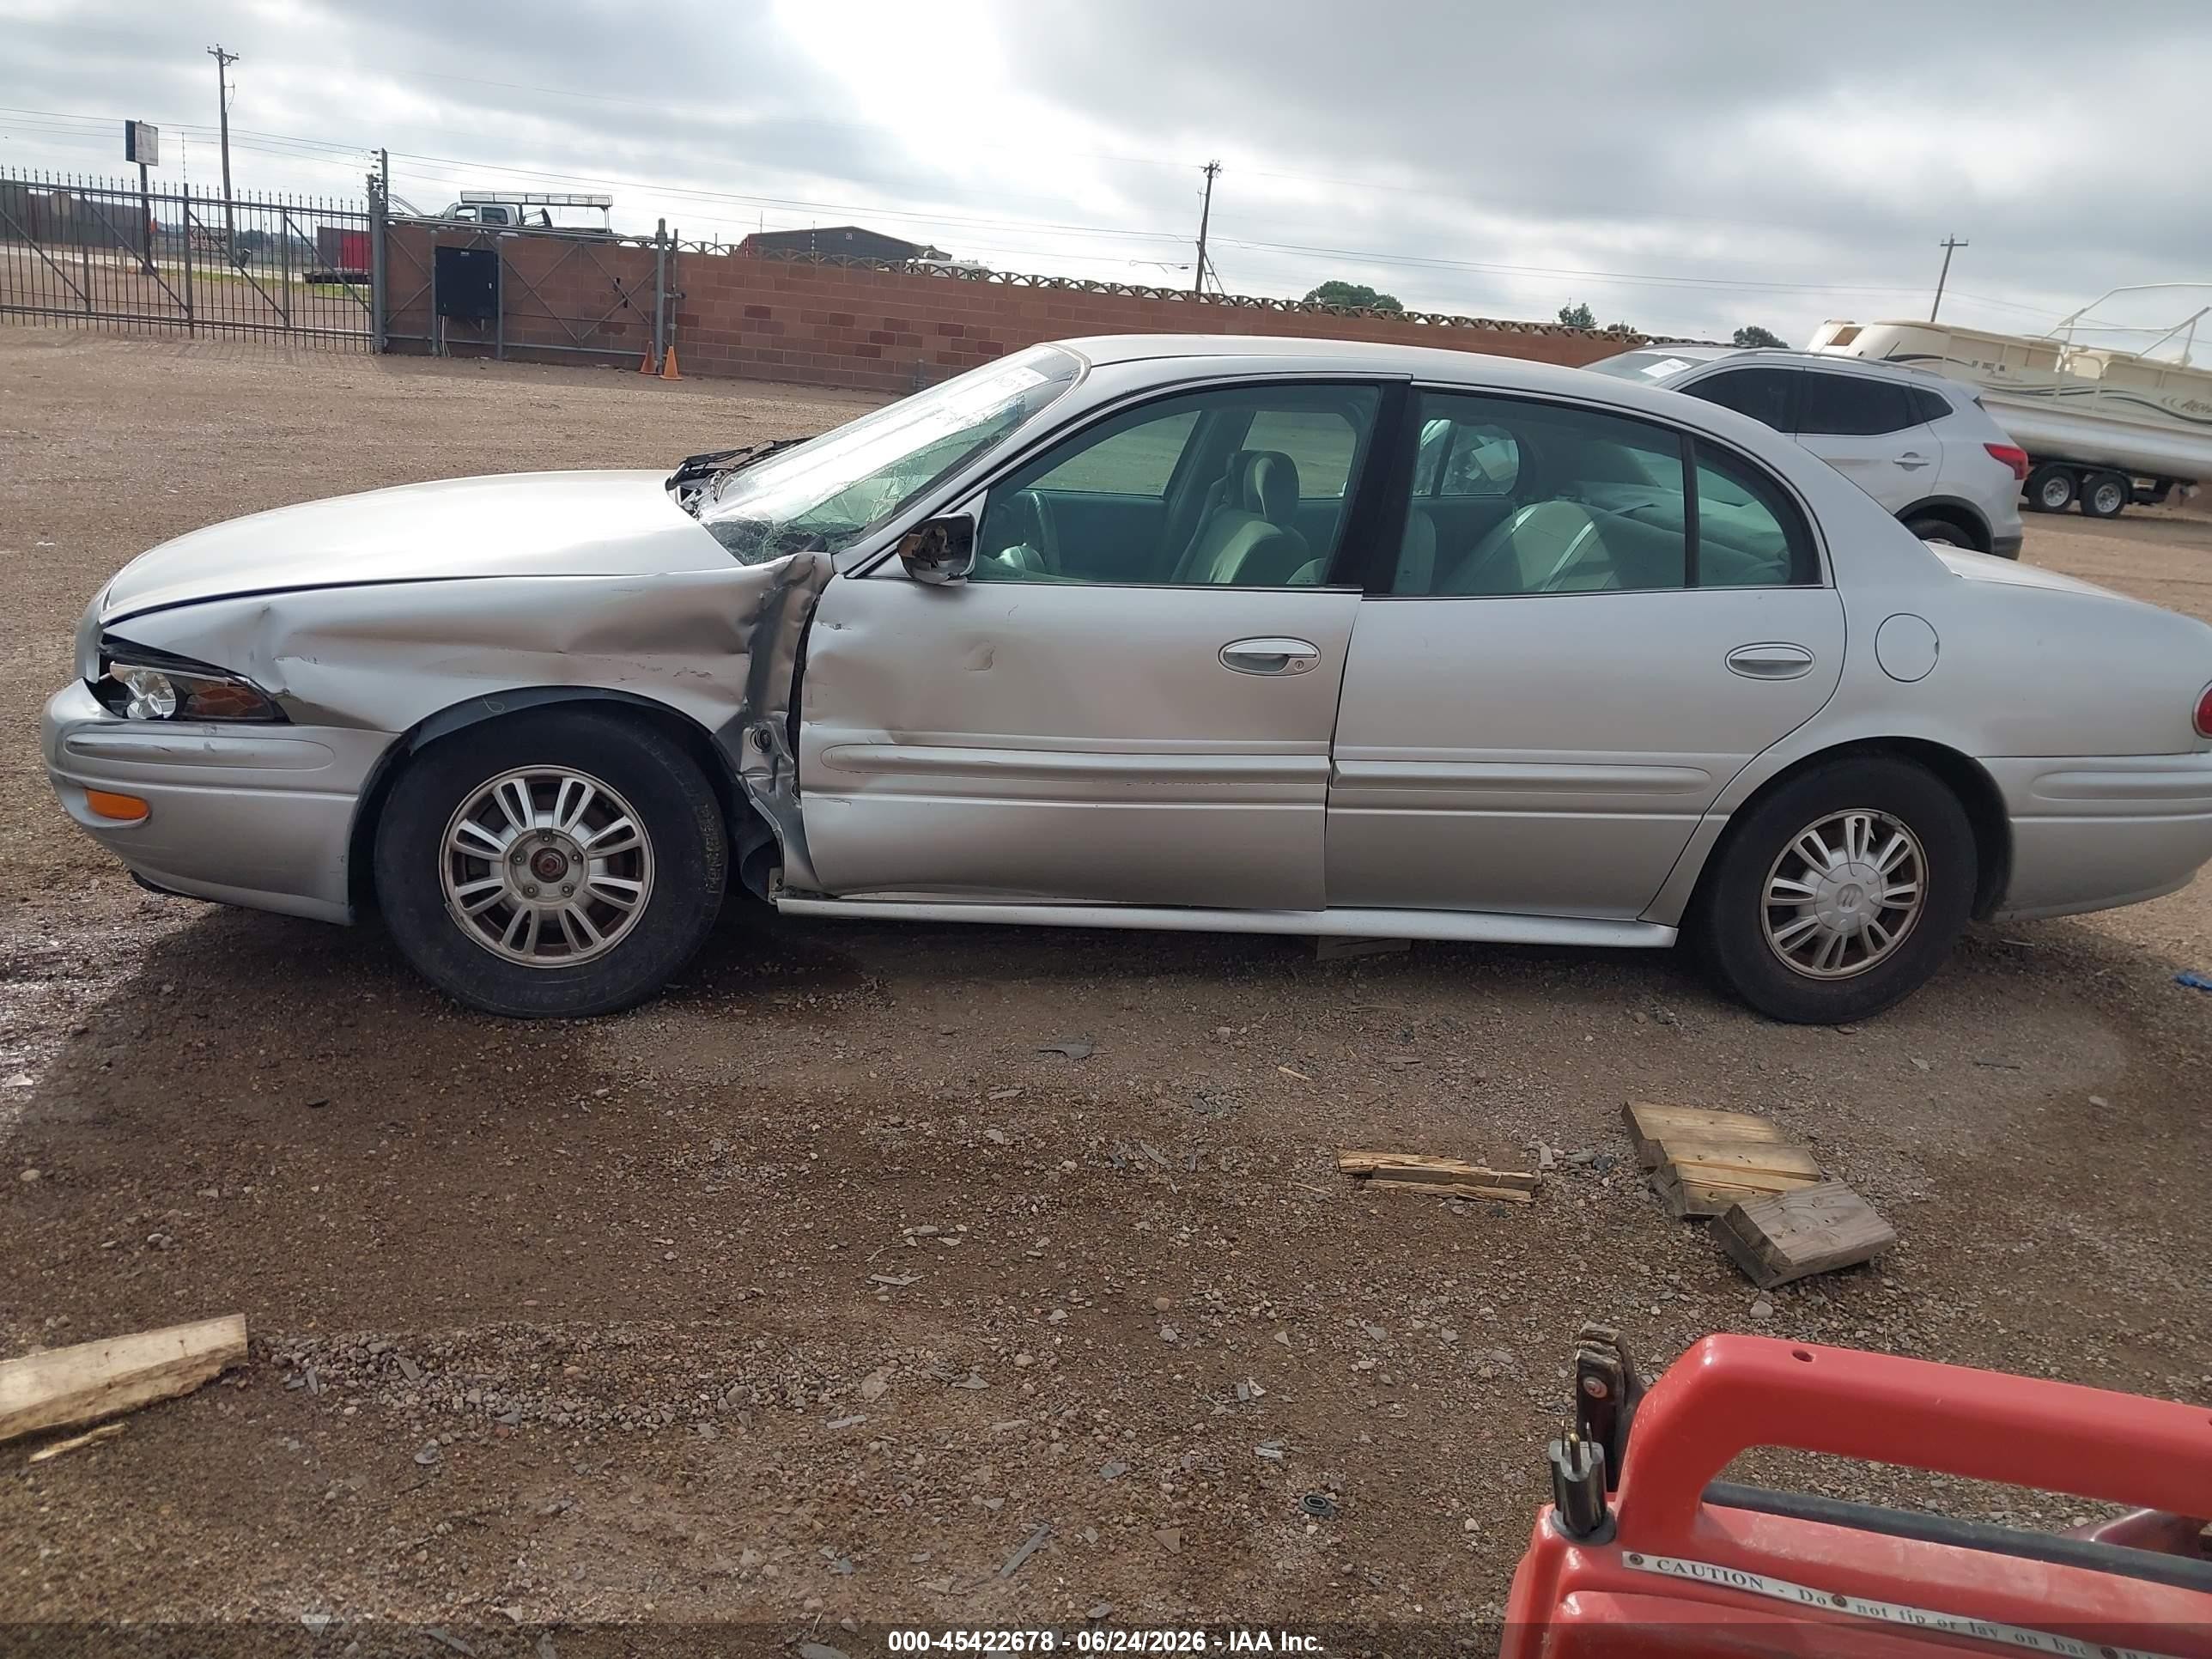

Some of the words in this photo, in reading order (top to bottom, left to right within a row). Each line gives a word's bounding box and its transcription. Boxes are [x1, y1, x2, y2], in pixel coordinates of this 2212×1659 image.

[1656, 1559, 1765, 1590] CAUTION
[1798, 1589, 1827, 1606] Do
[1856, 1603, 1889, 1619] not
[1899, 1608, 1926, 1626] tip
[1936, 1618, 1956, 1630] or
[1968, 1621, 1999, 1640] lay
[2014, 1632, 2039, 1646] on
